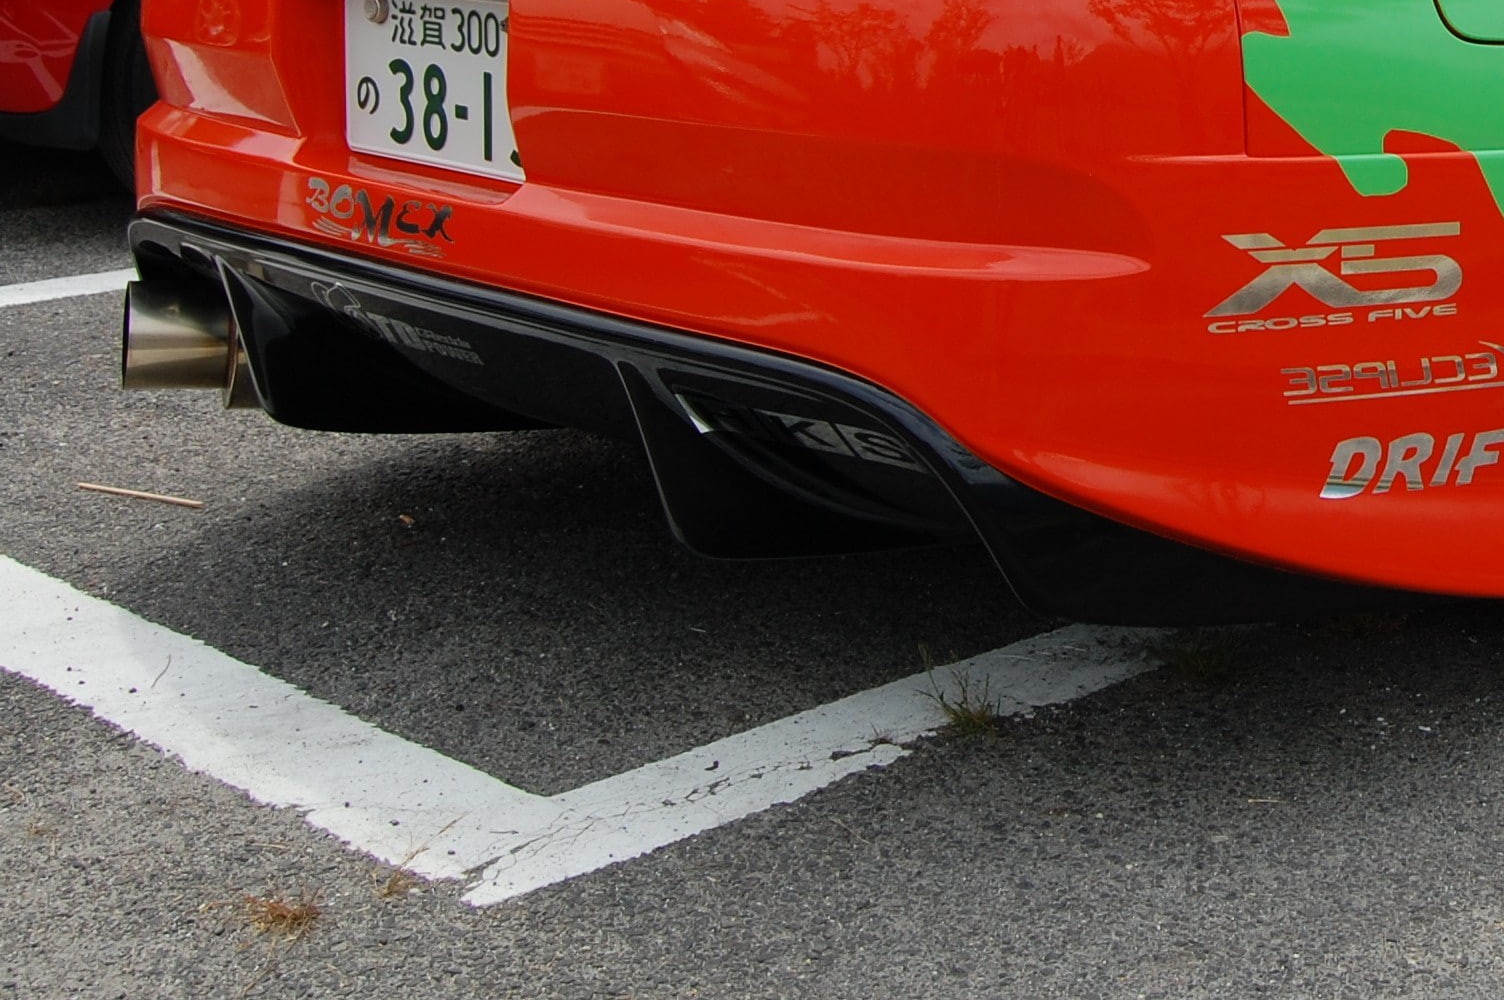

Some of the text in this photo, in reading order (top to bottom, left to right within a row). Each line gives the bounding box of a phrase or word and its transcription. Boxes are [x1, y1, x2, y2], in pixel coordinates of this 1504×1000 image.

[356, 58, 523, 168] の 38-1
[306, 177, 455, 247] BOMEX
[1203, 222, 1463, 318] X5
[1207, 303, 1458, 334] CROSS FIVE
